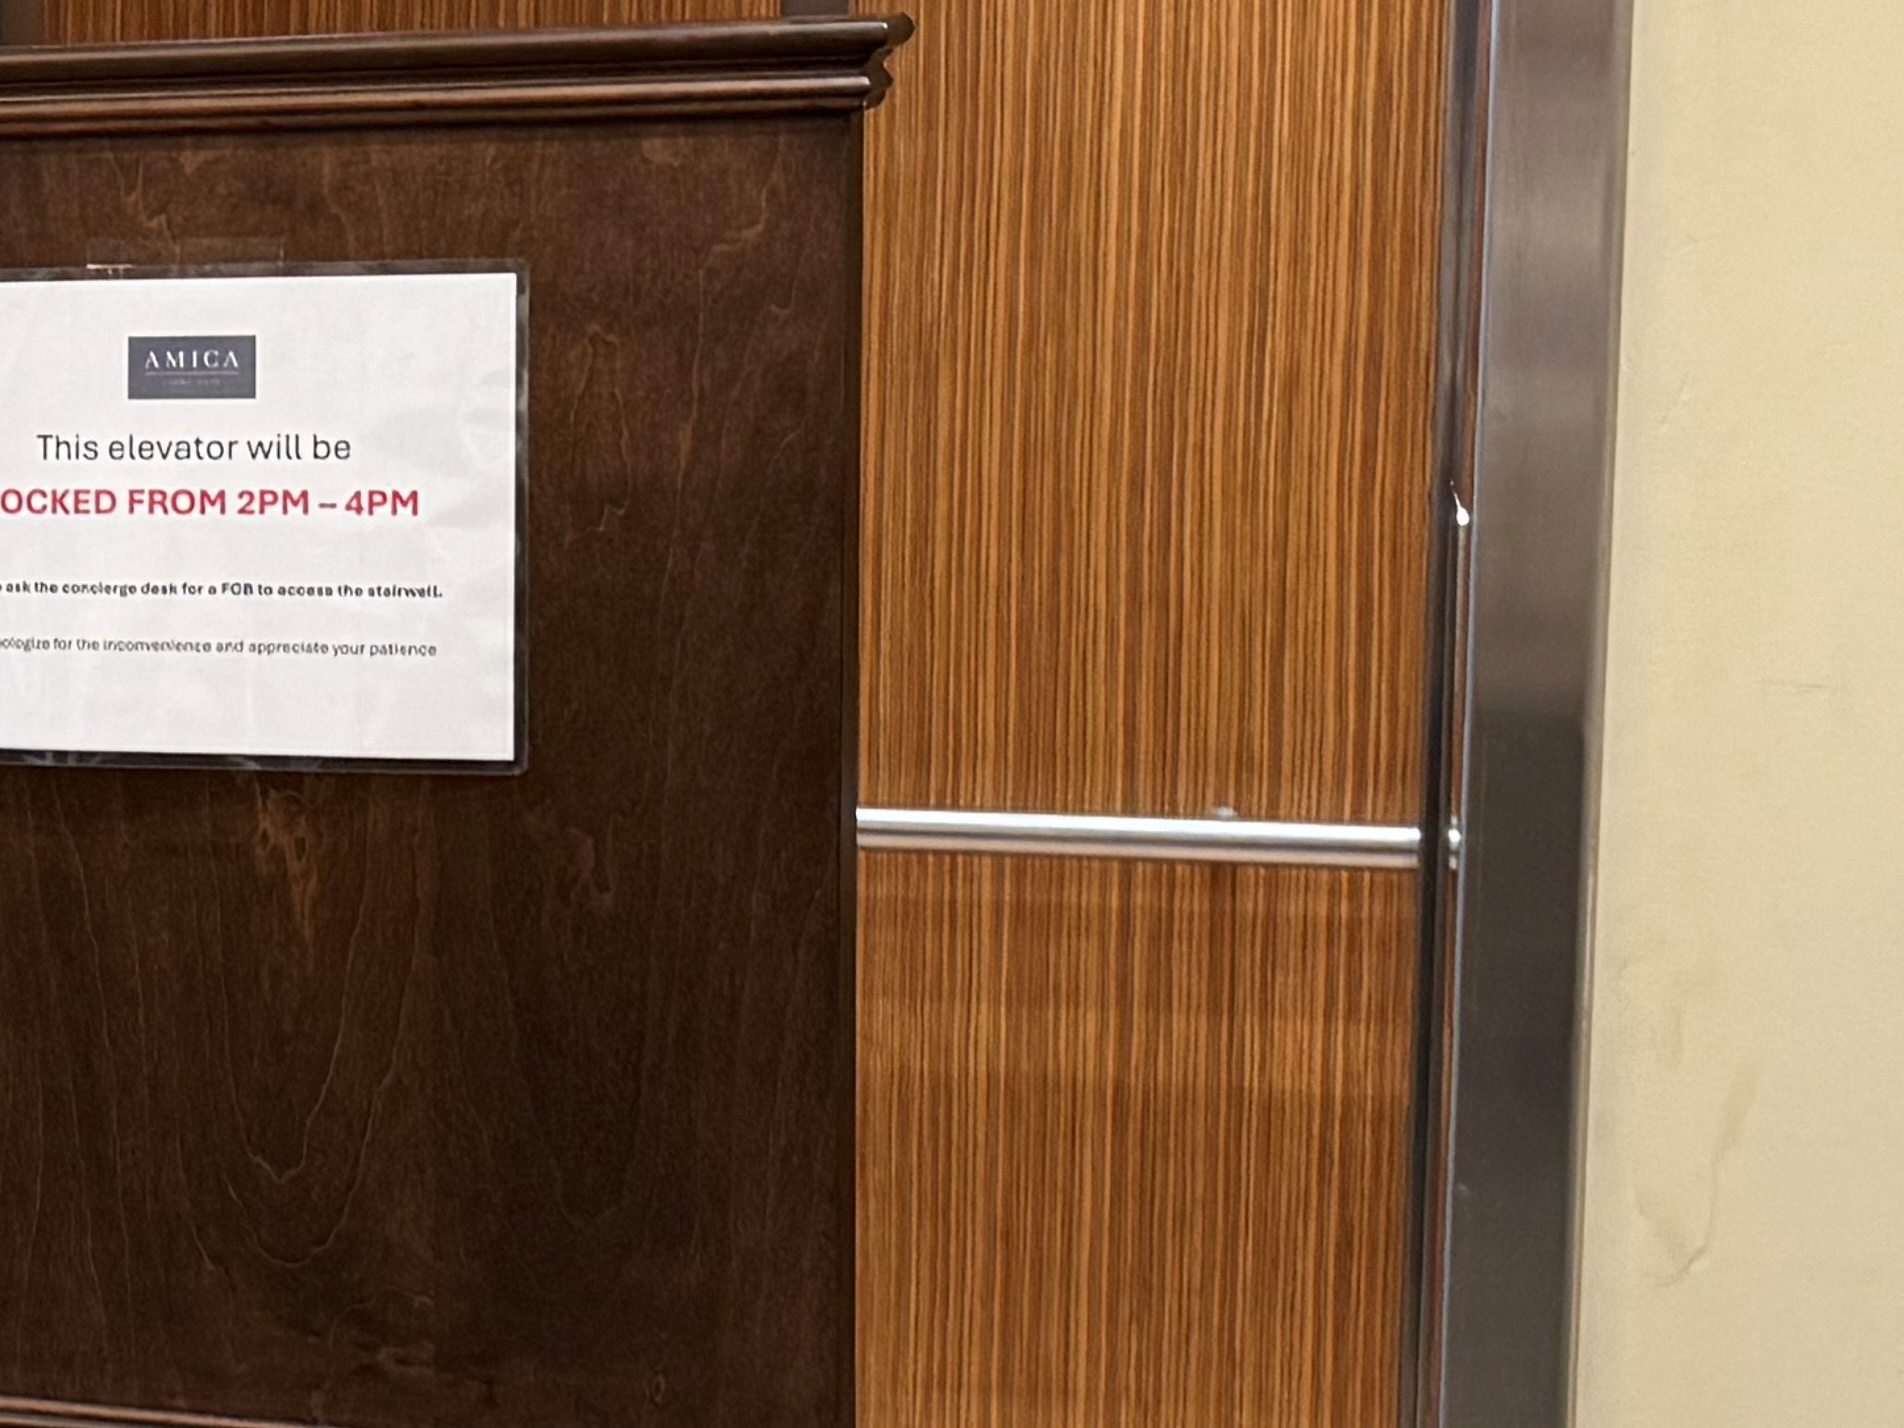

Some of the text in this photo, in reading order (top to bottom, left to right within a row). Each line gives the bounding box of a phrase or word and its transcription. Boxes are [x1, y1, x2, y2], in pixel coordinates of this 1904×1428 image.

[144, 349, 240, 370] AMICA
[36, 433, 352, 462] This elevator will be
[127, 488, 227, 516] FROM
[236, 488, 310, 516] 2PM
[344, 488, 420, 517] 4PM
[5, 580, 32, 594] ask
[34, 581, 59, 595] the
[61, 582, 138, 598] concierge
[140, 582, 178, 596] desk
[182, 582, 203, 596] for
[207, 585, 218, 596] a
[221, 582, 254, 596] FOB
[257, 583, 274, 597] to
[277, 585, 334, 597] access
[337, 583, 363, 597] the
[367, 584, 444, 599] stairwell.
[53, 637, 73, 651] for
[76, 637, 100, 651] the
[103, 638, 212, 653] inconvenience
[215, 639, 244, 653] and
[248, 641, 330, 656] appreciate
[331, 642, 366, 657] your
[369, 643, 438, 657] patience
